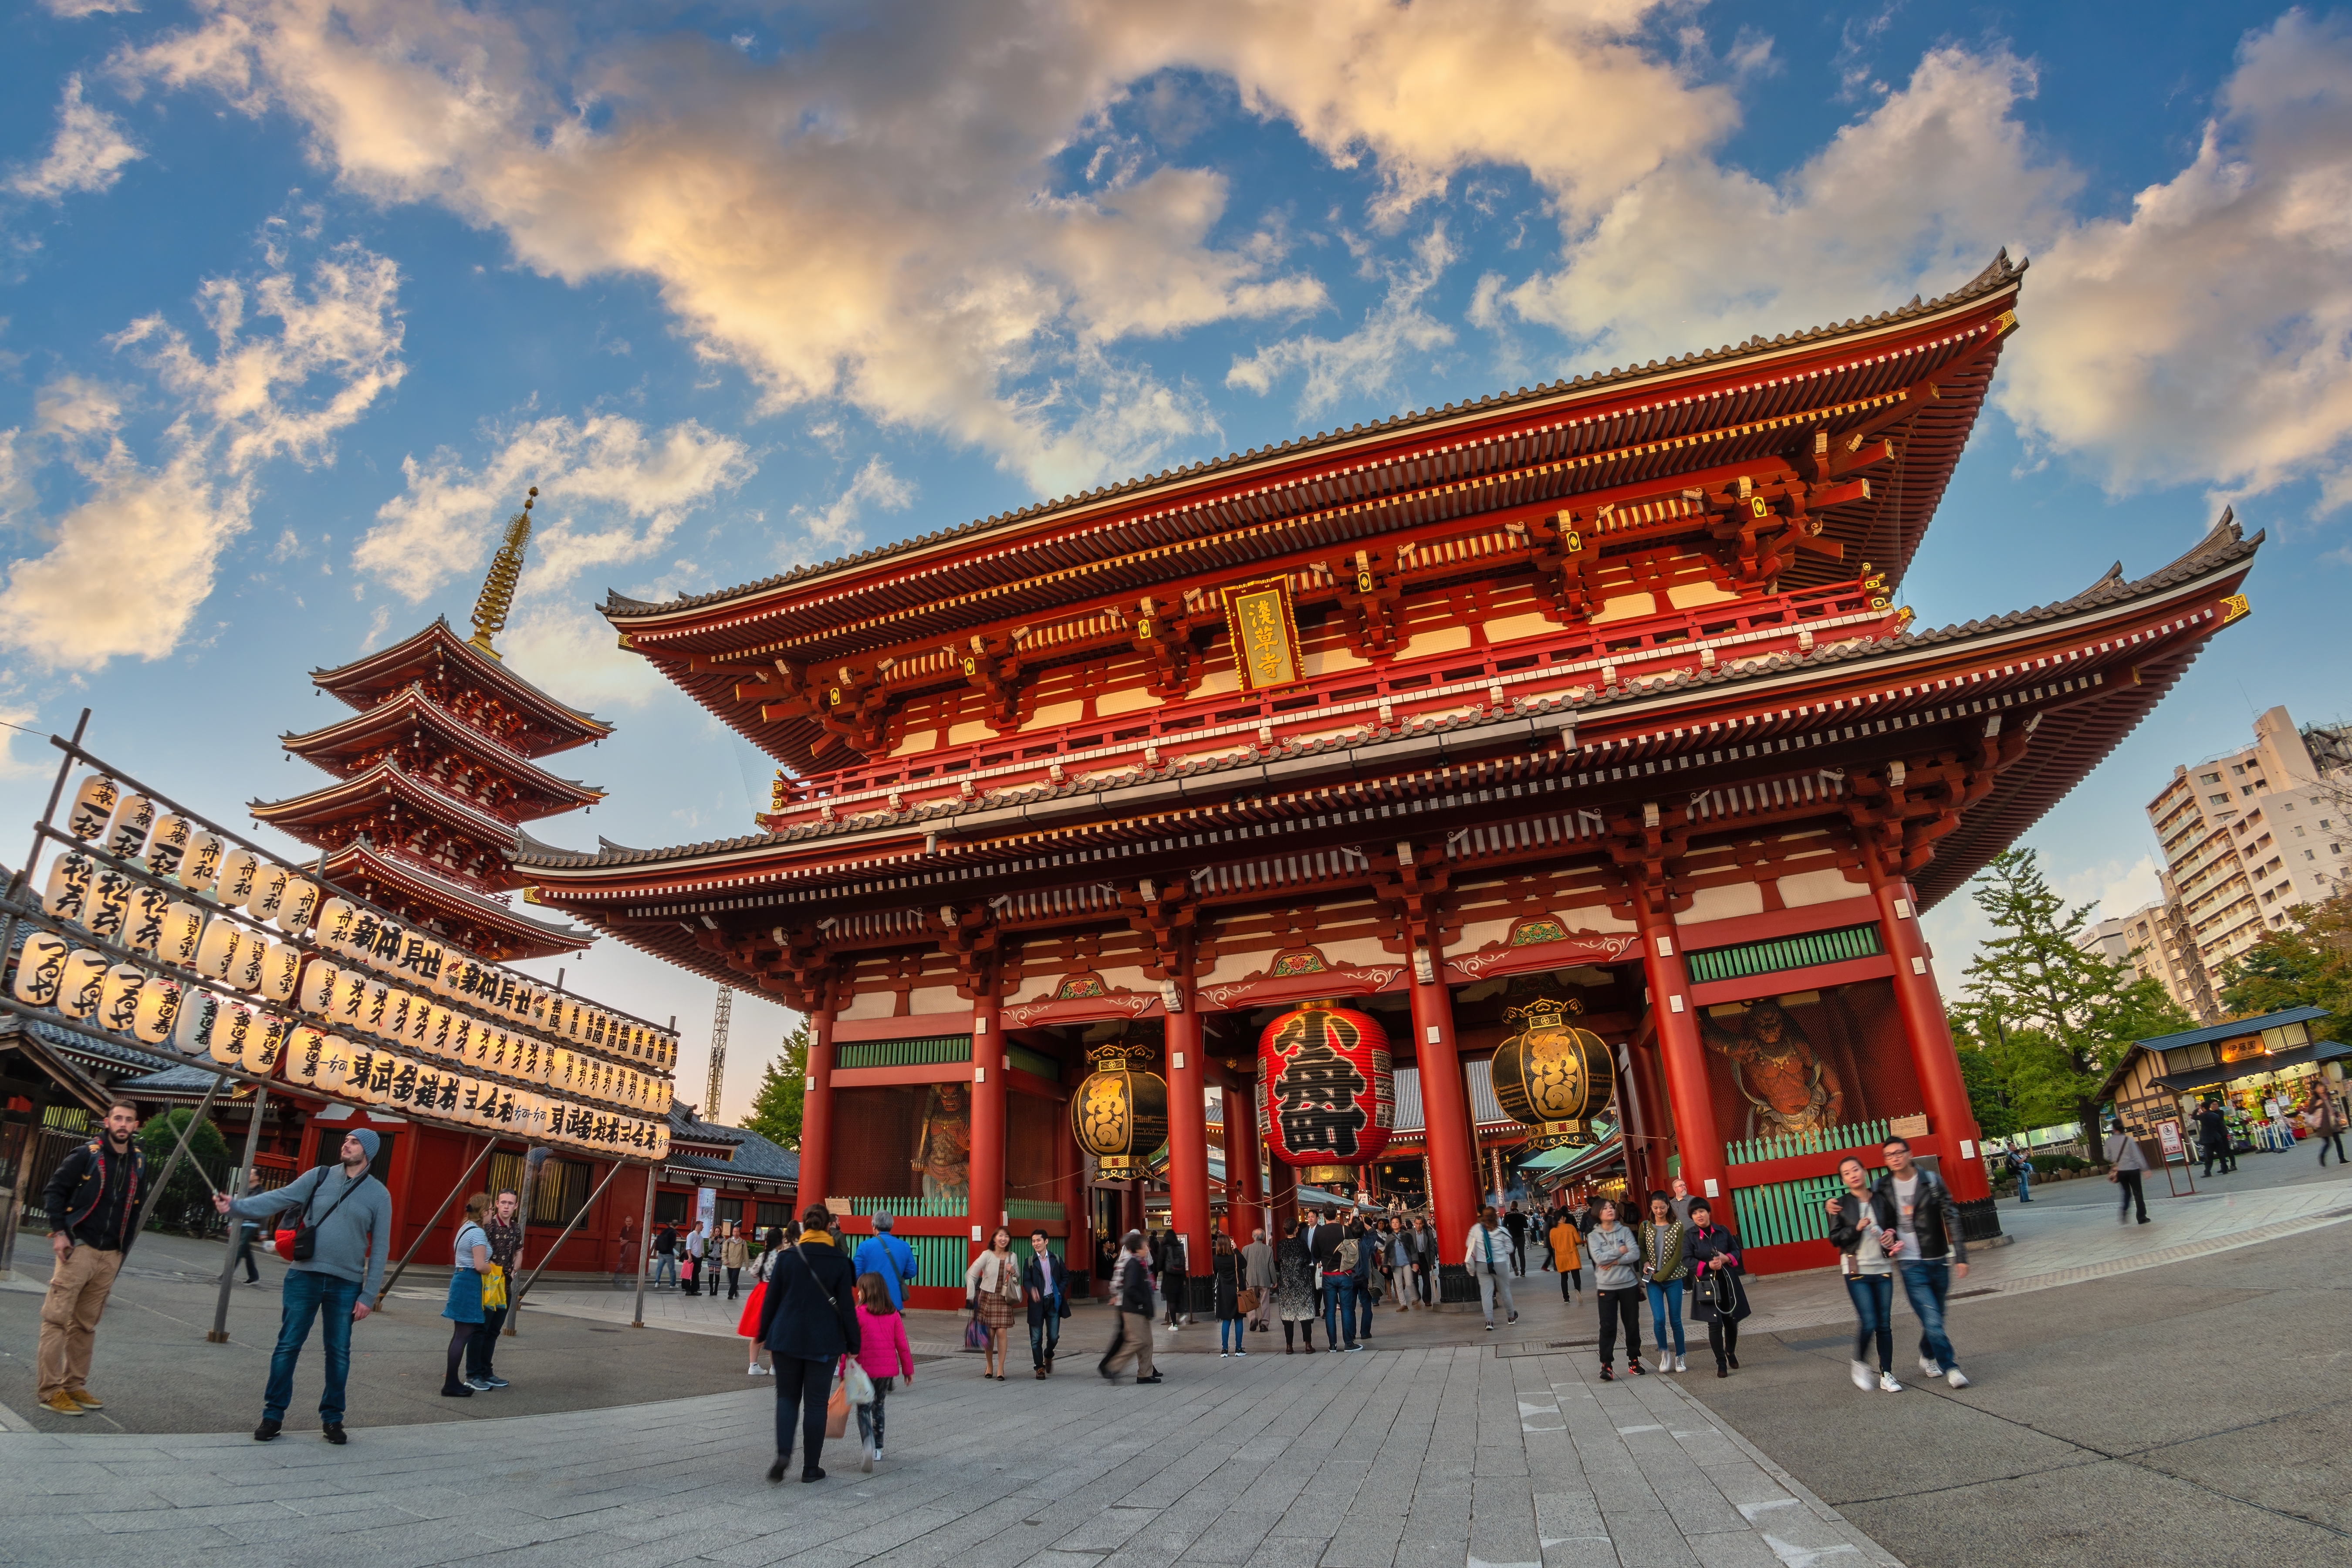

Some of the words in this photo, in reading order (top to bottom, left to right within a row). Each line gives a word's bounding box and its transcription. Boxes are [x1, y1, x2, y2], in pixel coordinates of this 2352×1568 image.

[193, 838, 219, 880] 舟和
[233, 856, 257, 897] 舟和
[263, 872, 286, 911] 舟和
[291, 887, 315, 926] 舟和
[331, 906, 353, 943] 舟和
[27, 942, 66, 1000] つるや
[71, 960, 108, 1015] つるや
[109, 974, 145, 1028] つるや
[1273, 1010, 1367, 1158] 小舟町
